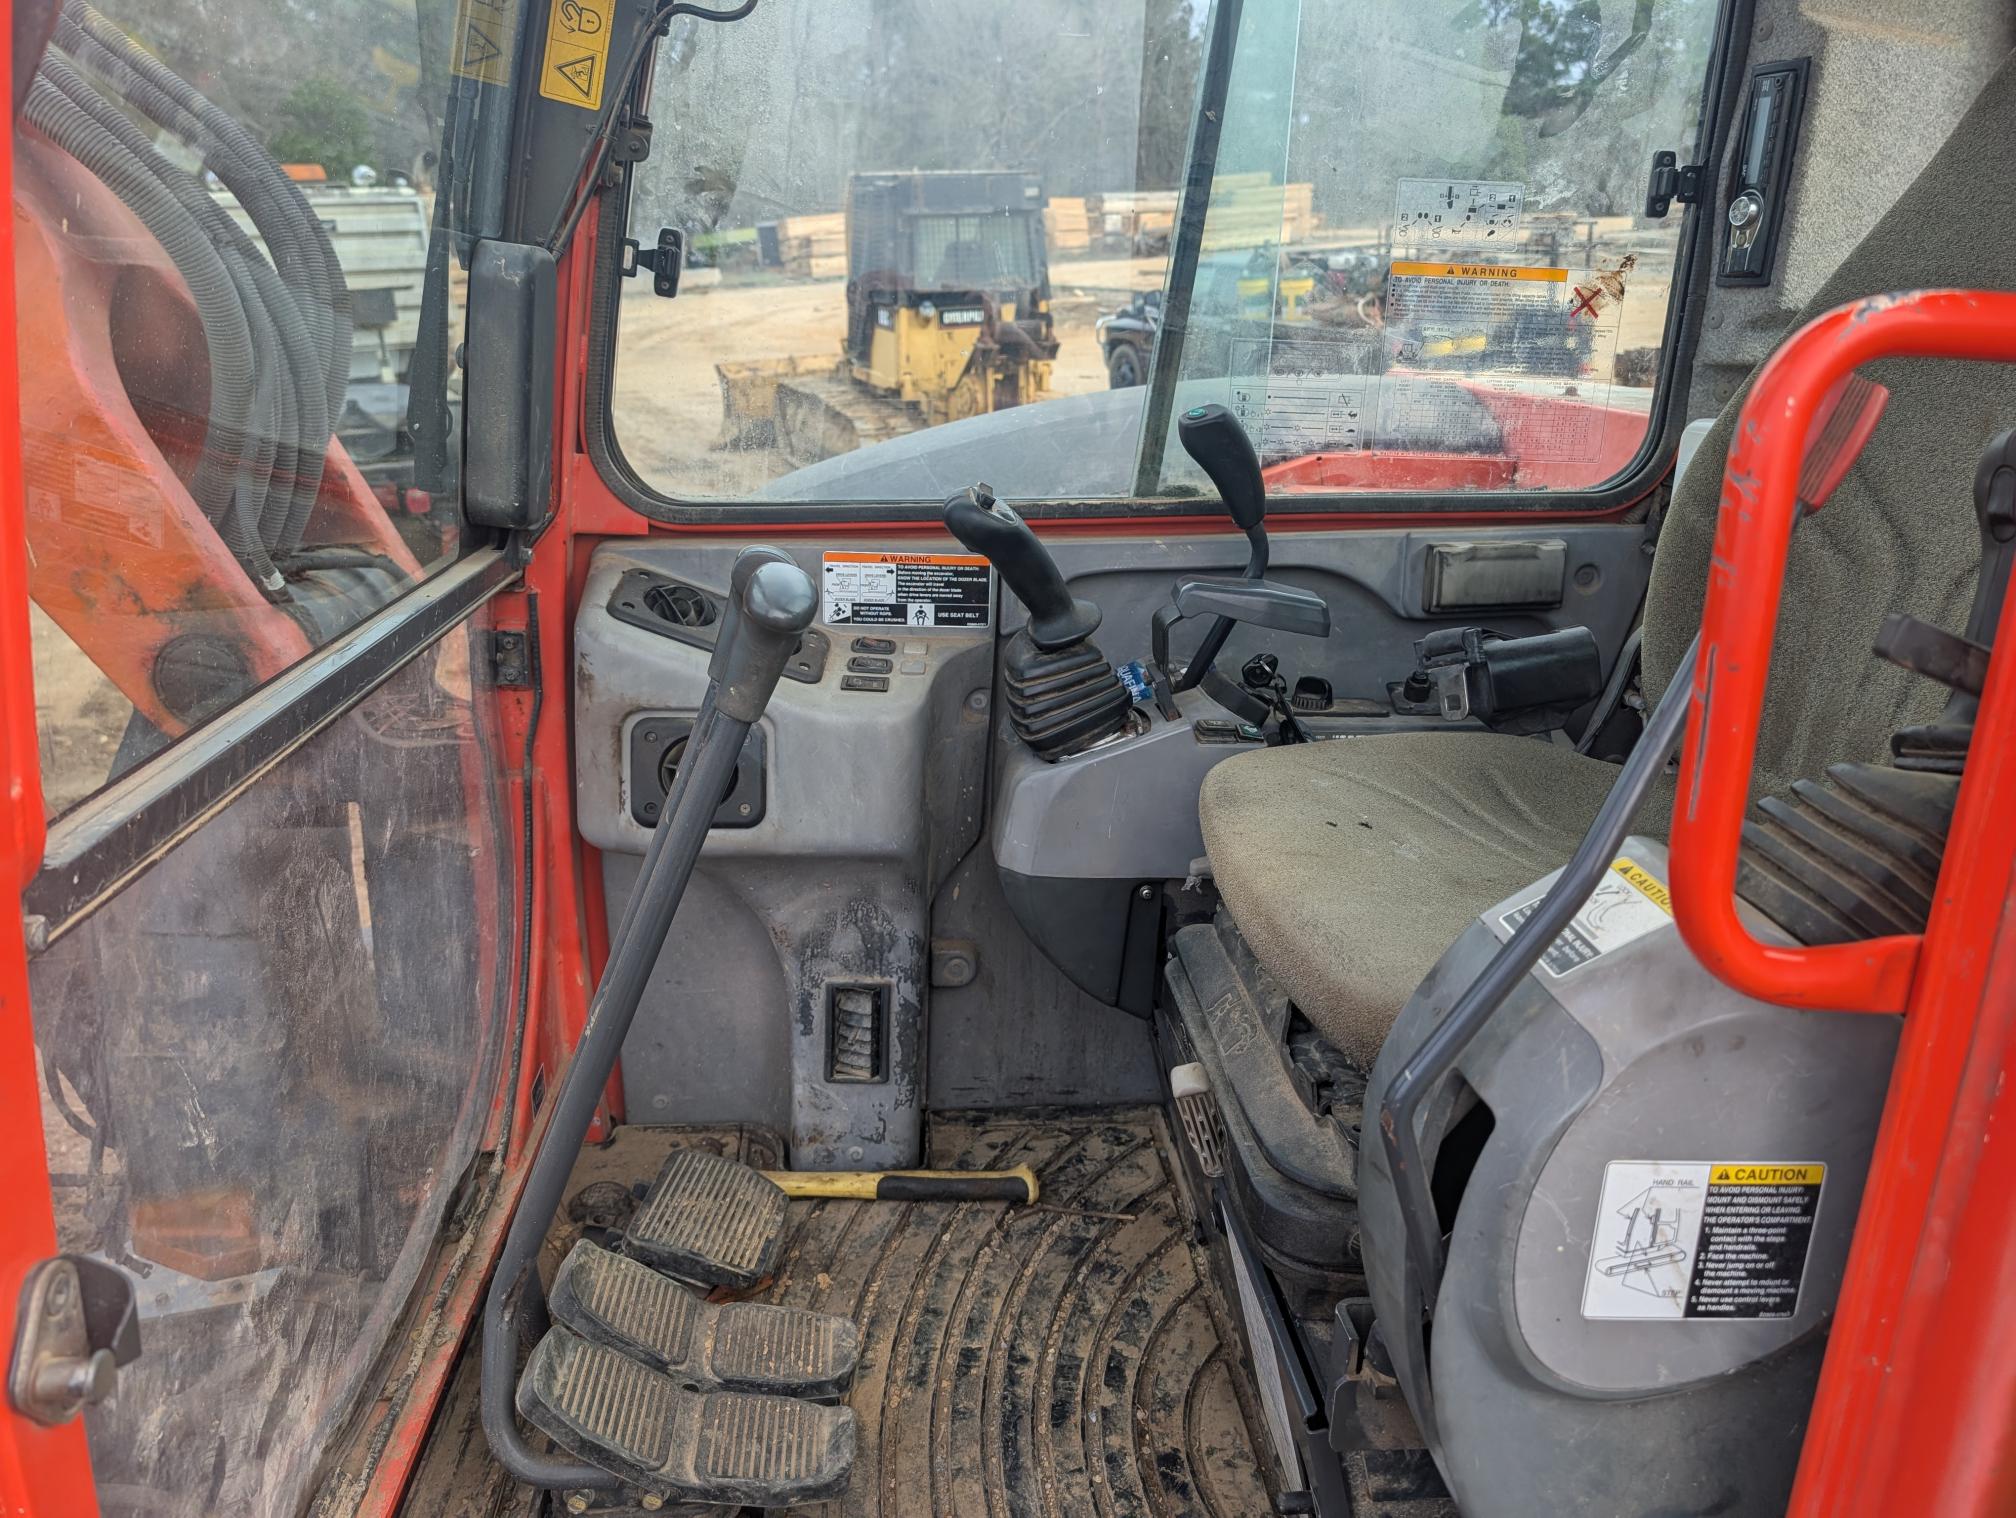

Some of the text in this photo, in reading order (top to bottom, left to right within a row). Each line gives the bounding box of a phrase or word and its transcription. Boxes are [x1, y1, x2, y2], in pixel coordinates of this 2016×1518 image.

[1461, 268, 1518, 278] WARNING
[890, 555, 932, 563] WARNING
[1630, 873, 1672, 909] CAUTIO
[1735, 1168, 1808, 1180] CAUTION
